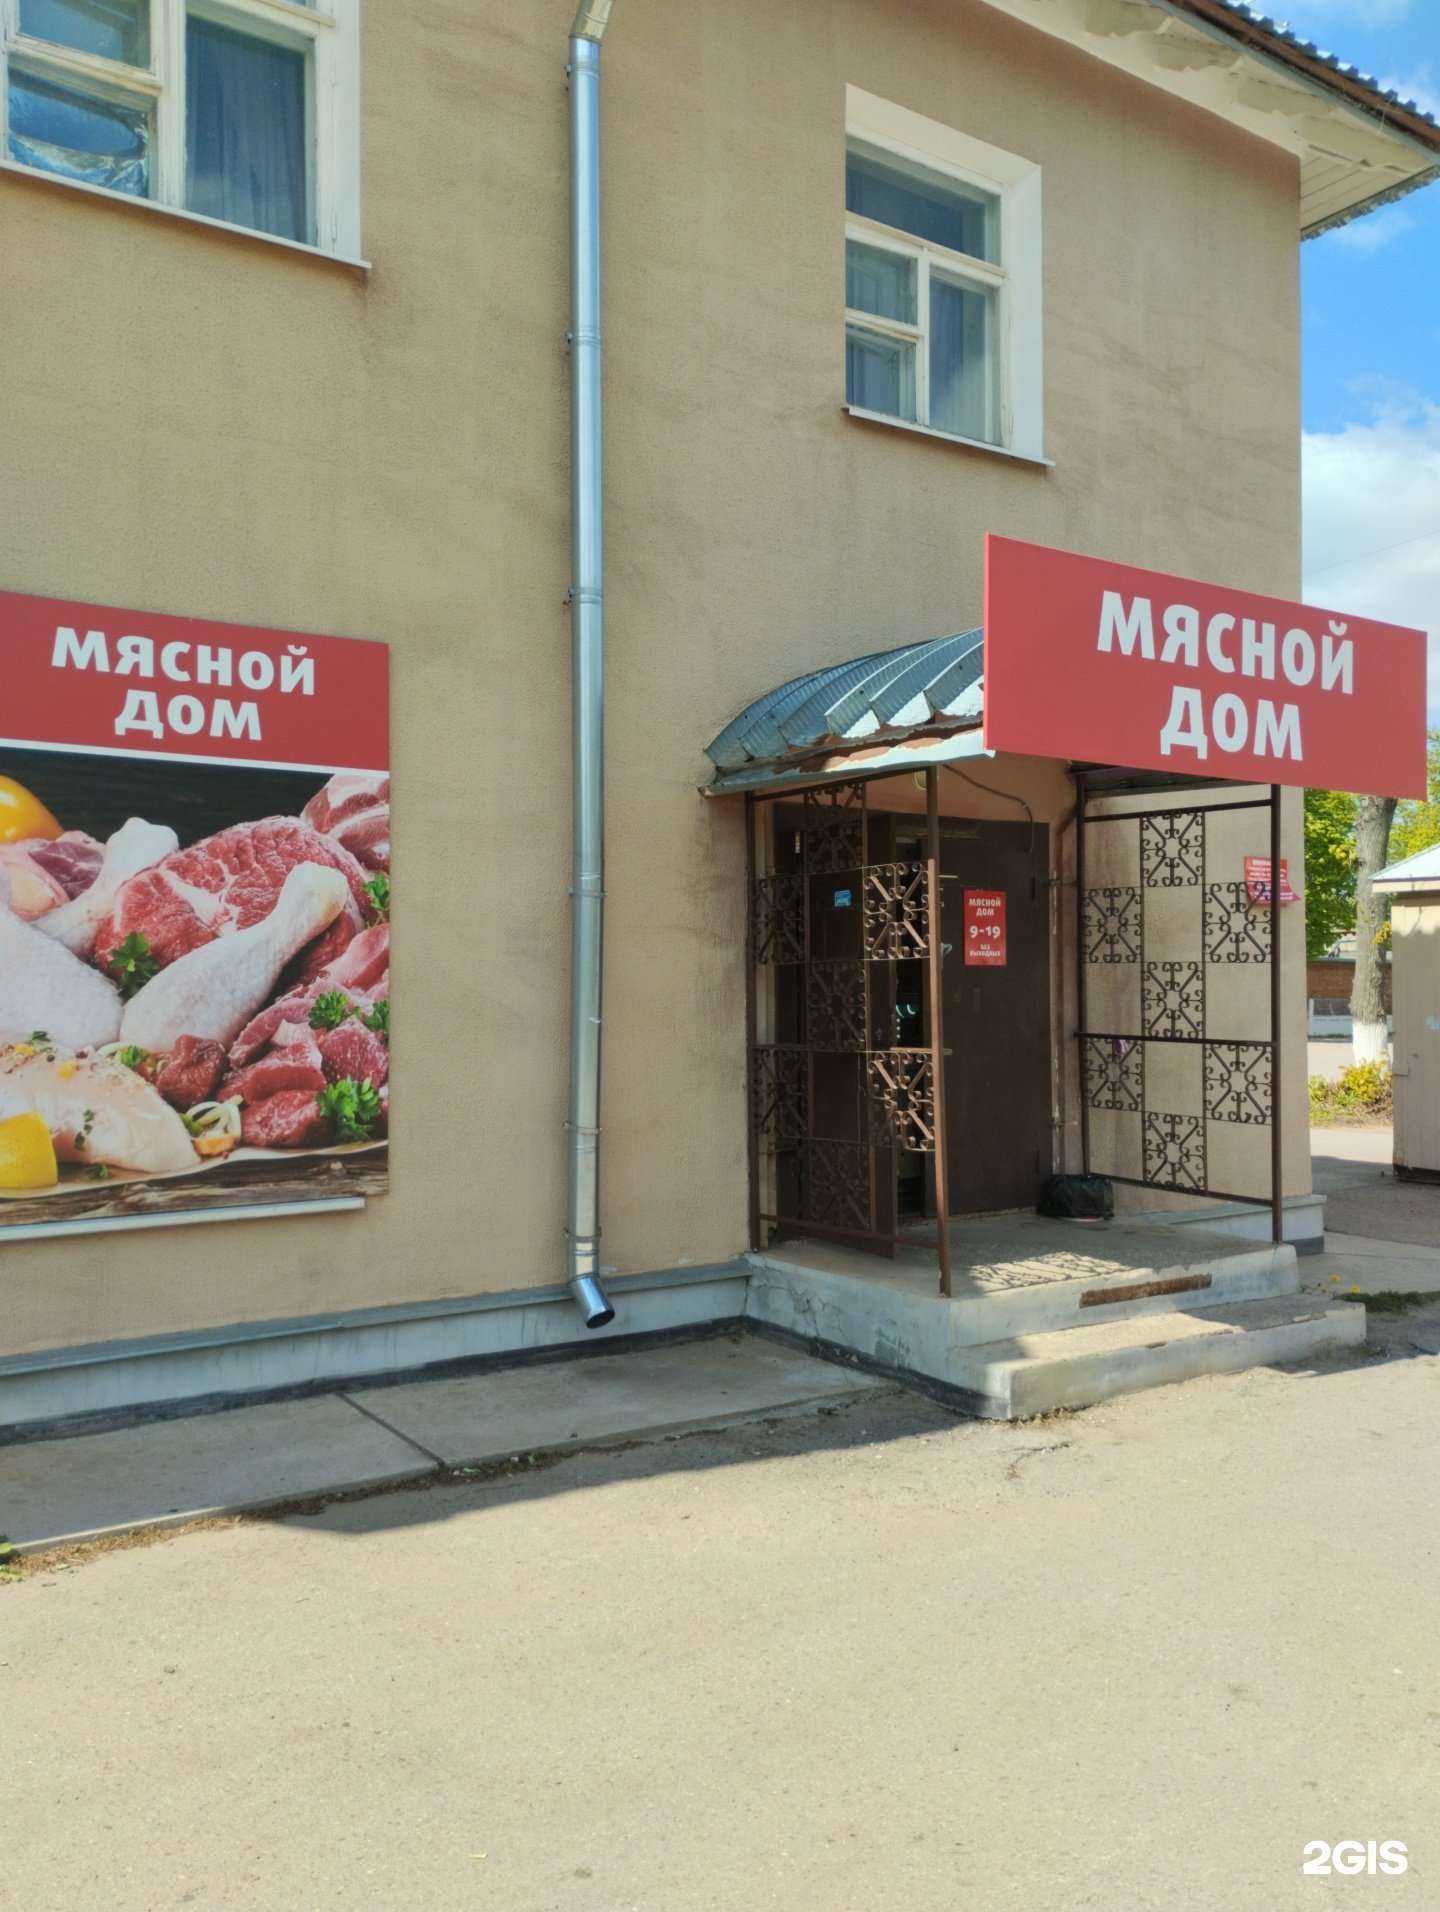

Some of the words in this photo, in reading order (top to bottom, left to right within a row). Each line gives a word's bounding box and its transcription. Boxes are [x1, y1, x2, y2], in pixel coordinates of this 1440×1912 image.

[51, 626, 315, 696] МЯСНОЙ
[1097, 590, 1354, 695] МЯСНОЙ
[114, 688, 262, 741] ДОМ
[1160, 685, 1304, 761] ДОМ
[969, 897, 1001, 906] МЯСНОЙ
[976, 908, 995, 917] ДОМ
[969, 925, 1001, 939] 9-19
